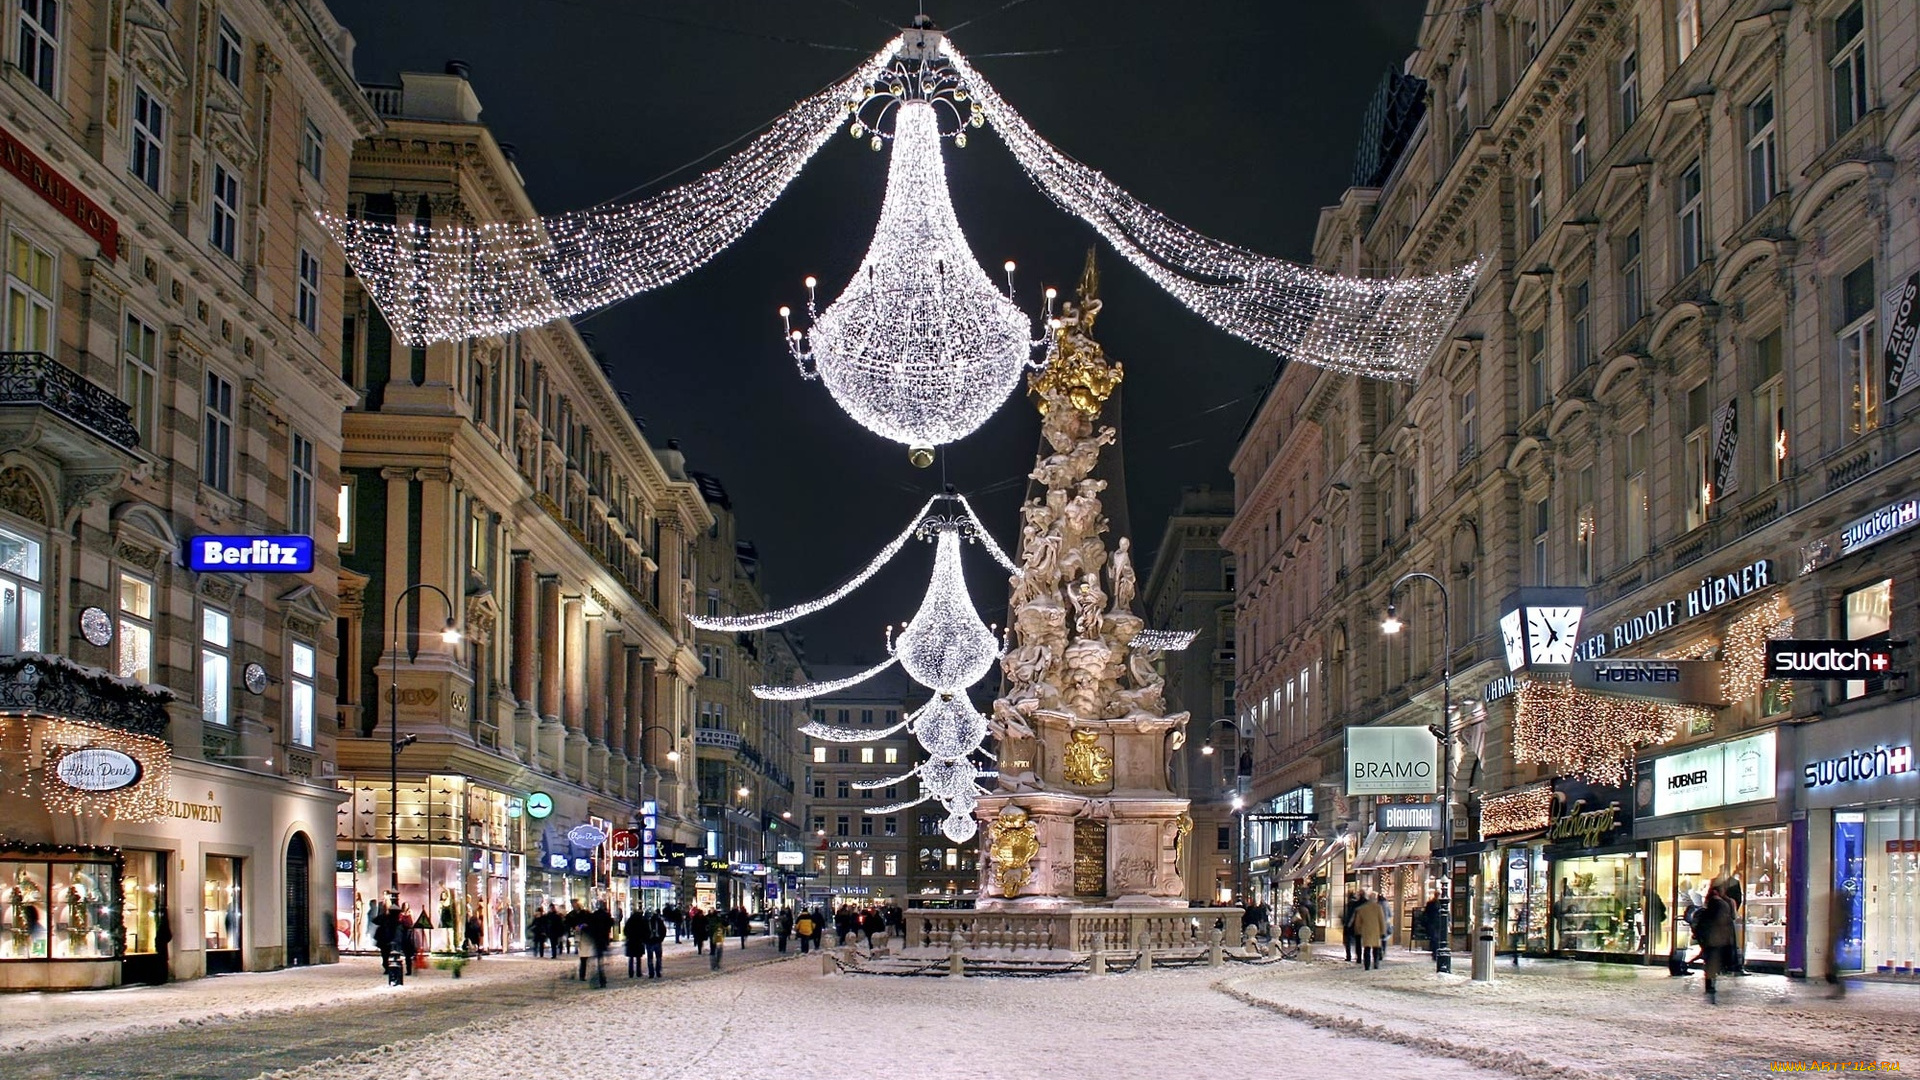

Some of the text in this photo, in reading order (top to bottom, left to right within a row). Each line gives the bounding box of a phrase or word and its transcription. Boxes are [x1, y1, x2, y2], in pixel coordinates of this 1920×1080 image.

[0, 136, 69, 208] NERALI
[1888, 284, 1917, 355] ZIKOS
[1889, 325, 1916, 387] FURS
[1716, 407, 1735, 463] ZIKOS
[1716, 431, 1738, 489] PELZE
[1841, 504, 1900, 550] swatch
[203, 540, 298, 564] Berlitz
[1573, 633, 1606, 662] STER
[1613, 600, 1676, 649] RUDOLF
[1687, 559, 1768, 618] HÜBNER
[1775, 648, 1870, 671] swatch
[97, 762, 131, 777] Denk
[1354, 761, 1431, 778] BRAMO
[1804, 746, 1888, 789] swatch
[156, 799, 222, 823] ELDWEIN
[842, 841, 868, 849] MMO
